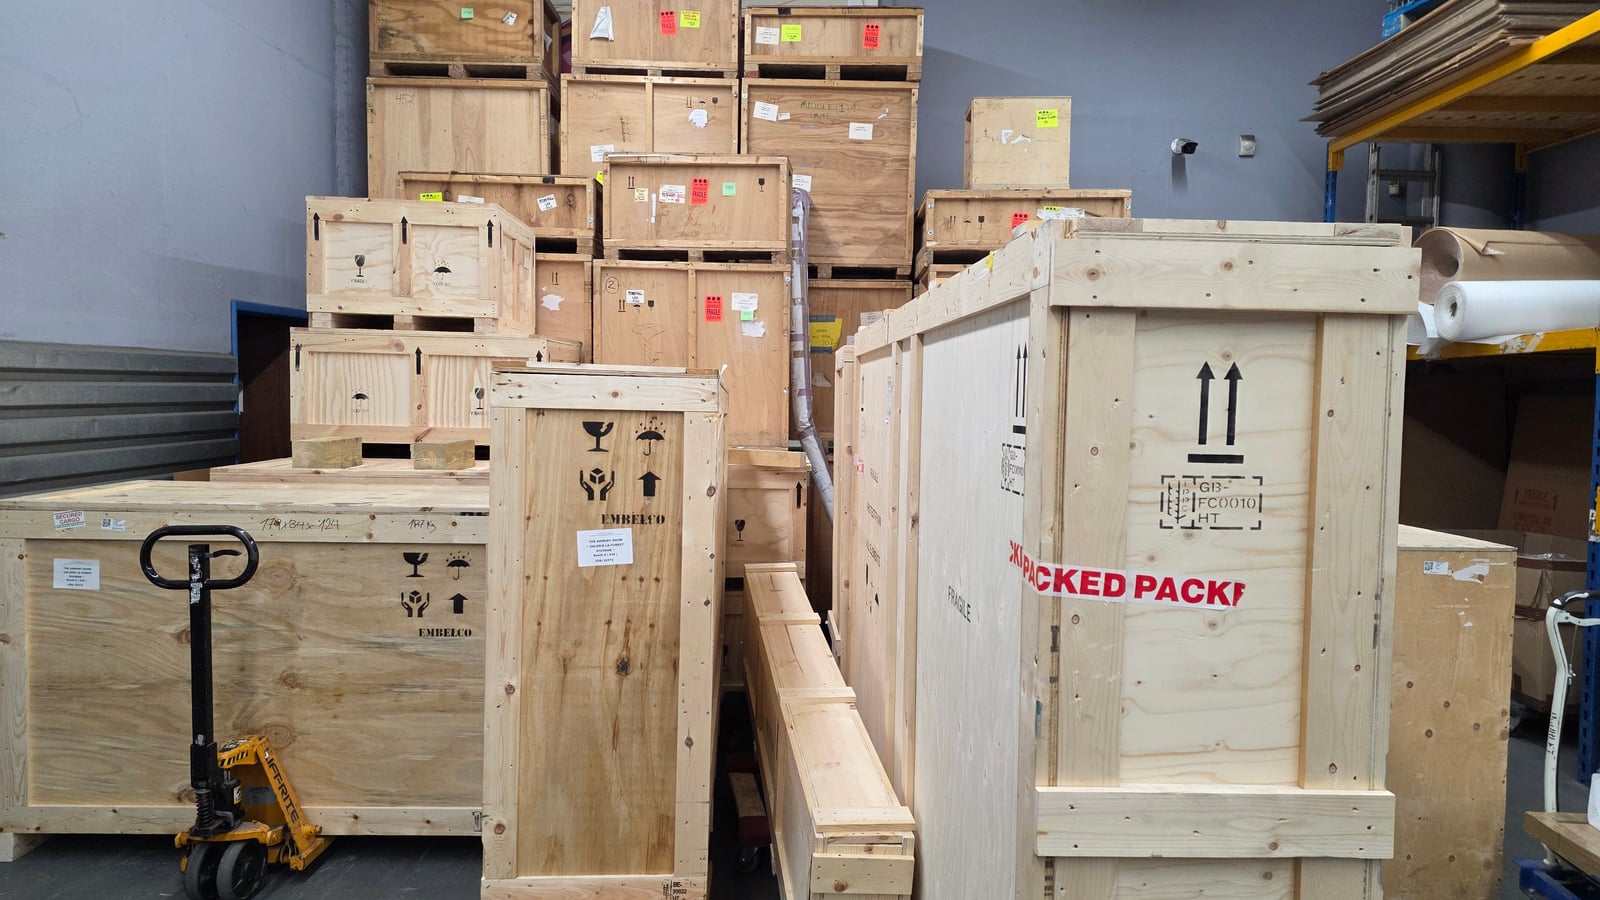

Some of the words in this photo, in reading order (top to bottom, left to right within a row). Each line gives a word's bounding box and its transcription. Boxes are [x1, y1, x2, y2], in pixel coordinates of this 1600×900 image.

[1198, 497, 1256, 509] FC0010
[55, 511, 83, 520] SECURED
[59, 517, 80, 525] CARGO
[601, 513, 665, 525] EMBELCO
[1198, 513, 1220, 523] HT
[1023, 553, 1126, 598] PACKED
[947, 585, 972, 624] FRAGILE
[418, 628, 472, 638] EMBELCO
